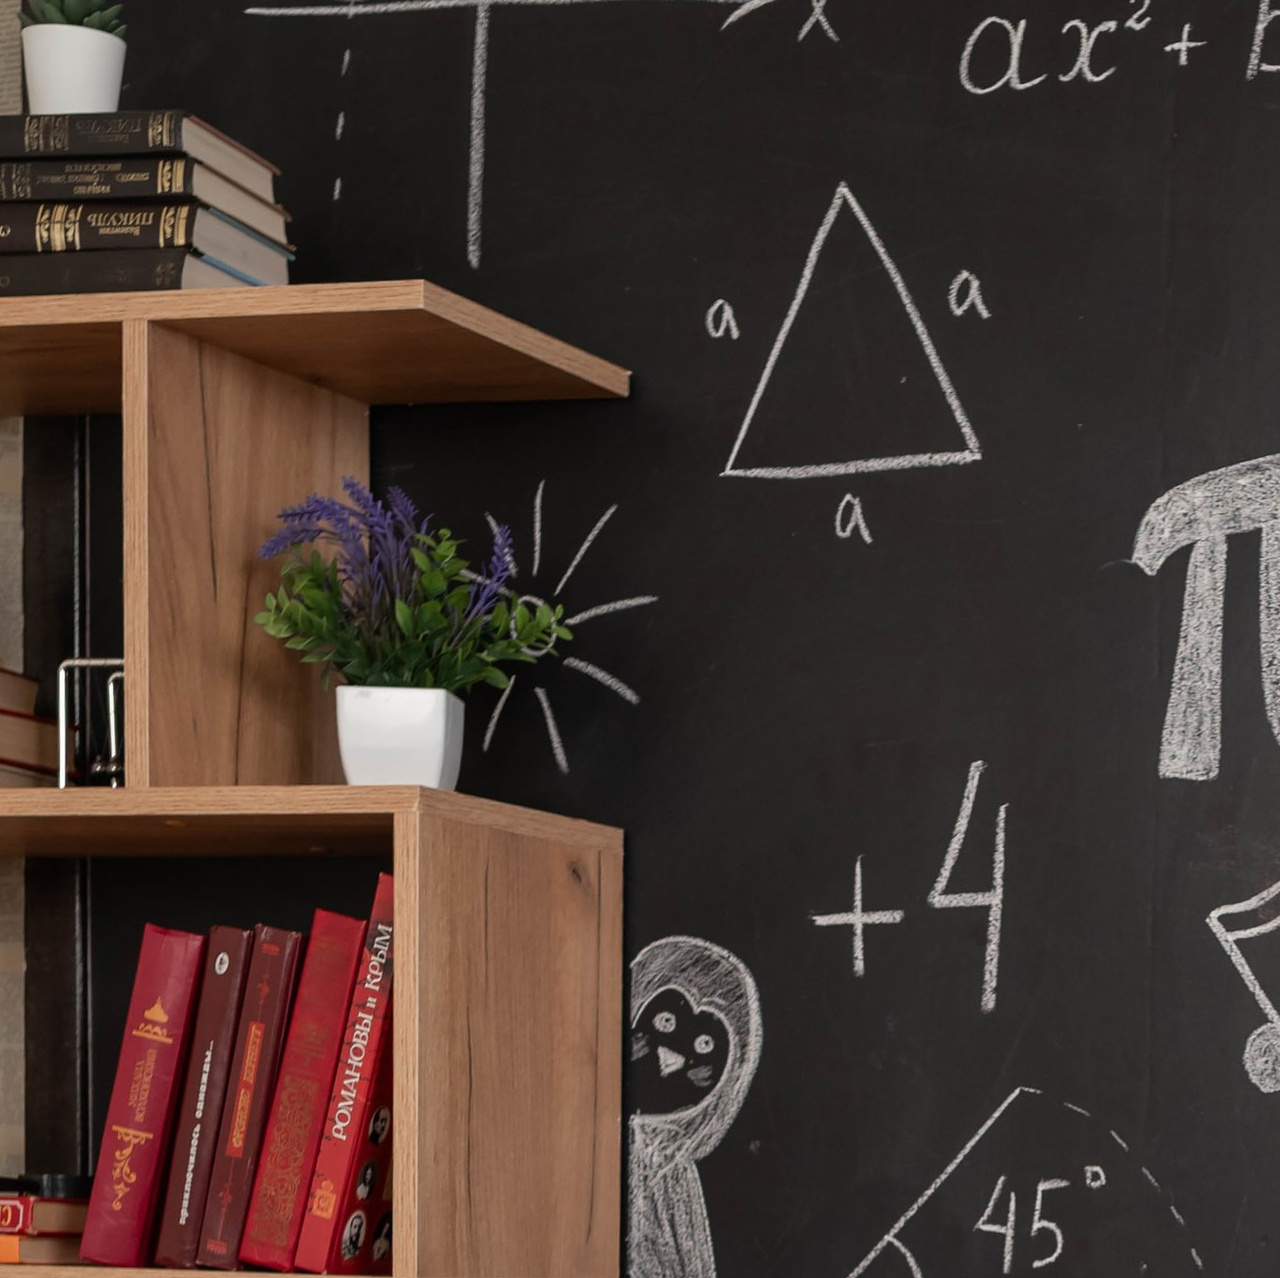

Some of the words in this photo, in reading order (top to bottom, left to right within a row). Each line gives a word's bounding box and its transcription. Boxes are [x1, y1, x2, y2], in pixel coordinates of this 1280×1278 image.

[87, 212, 155, 227] ПИКУЛЬ
[706, 299, 739, 339] a
[948, 270, 991, 319] a
[835, 493, 872, 544] a
[332, 1012, 373, 1141] РОМАНОВЫ
[365, 924, 393, 991] КРЫМ
